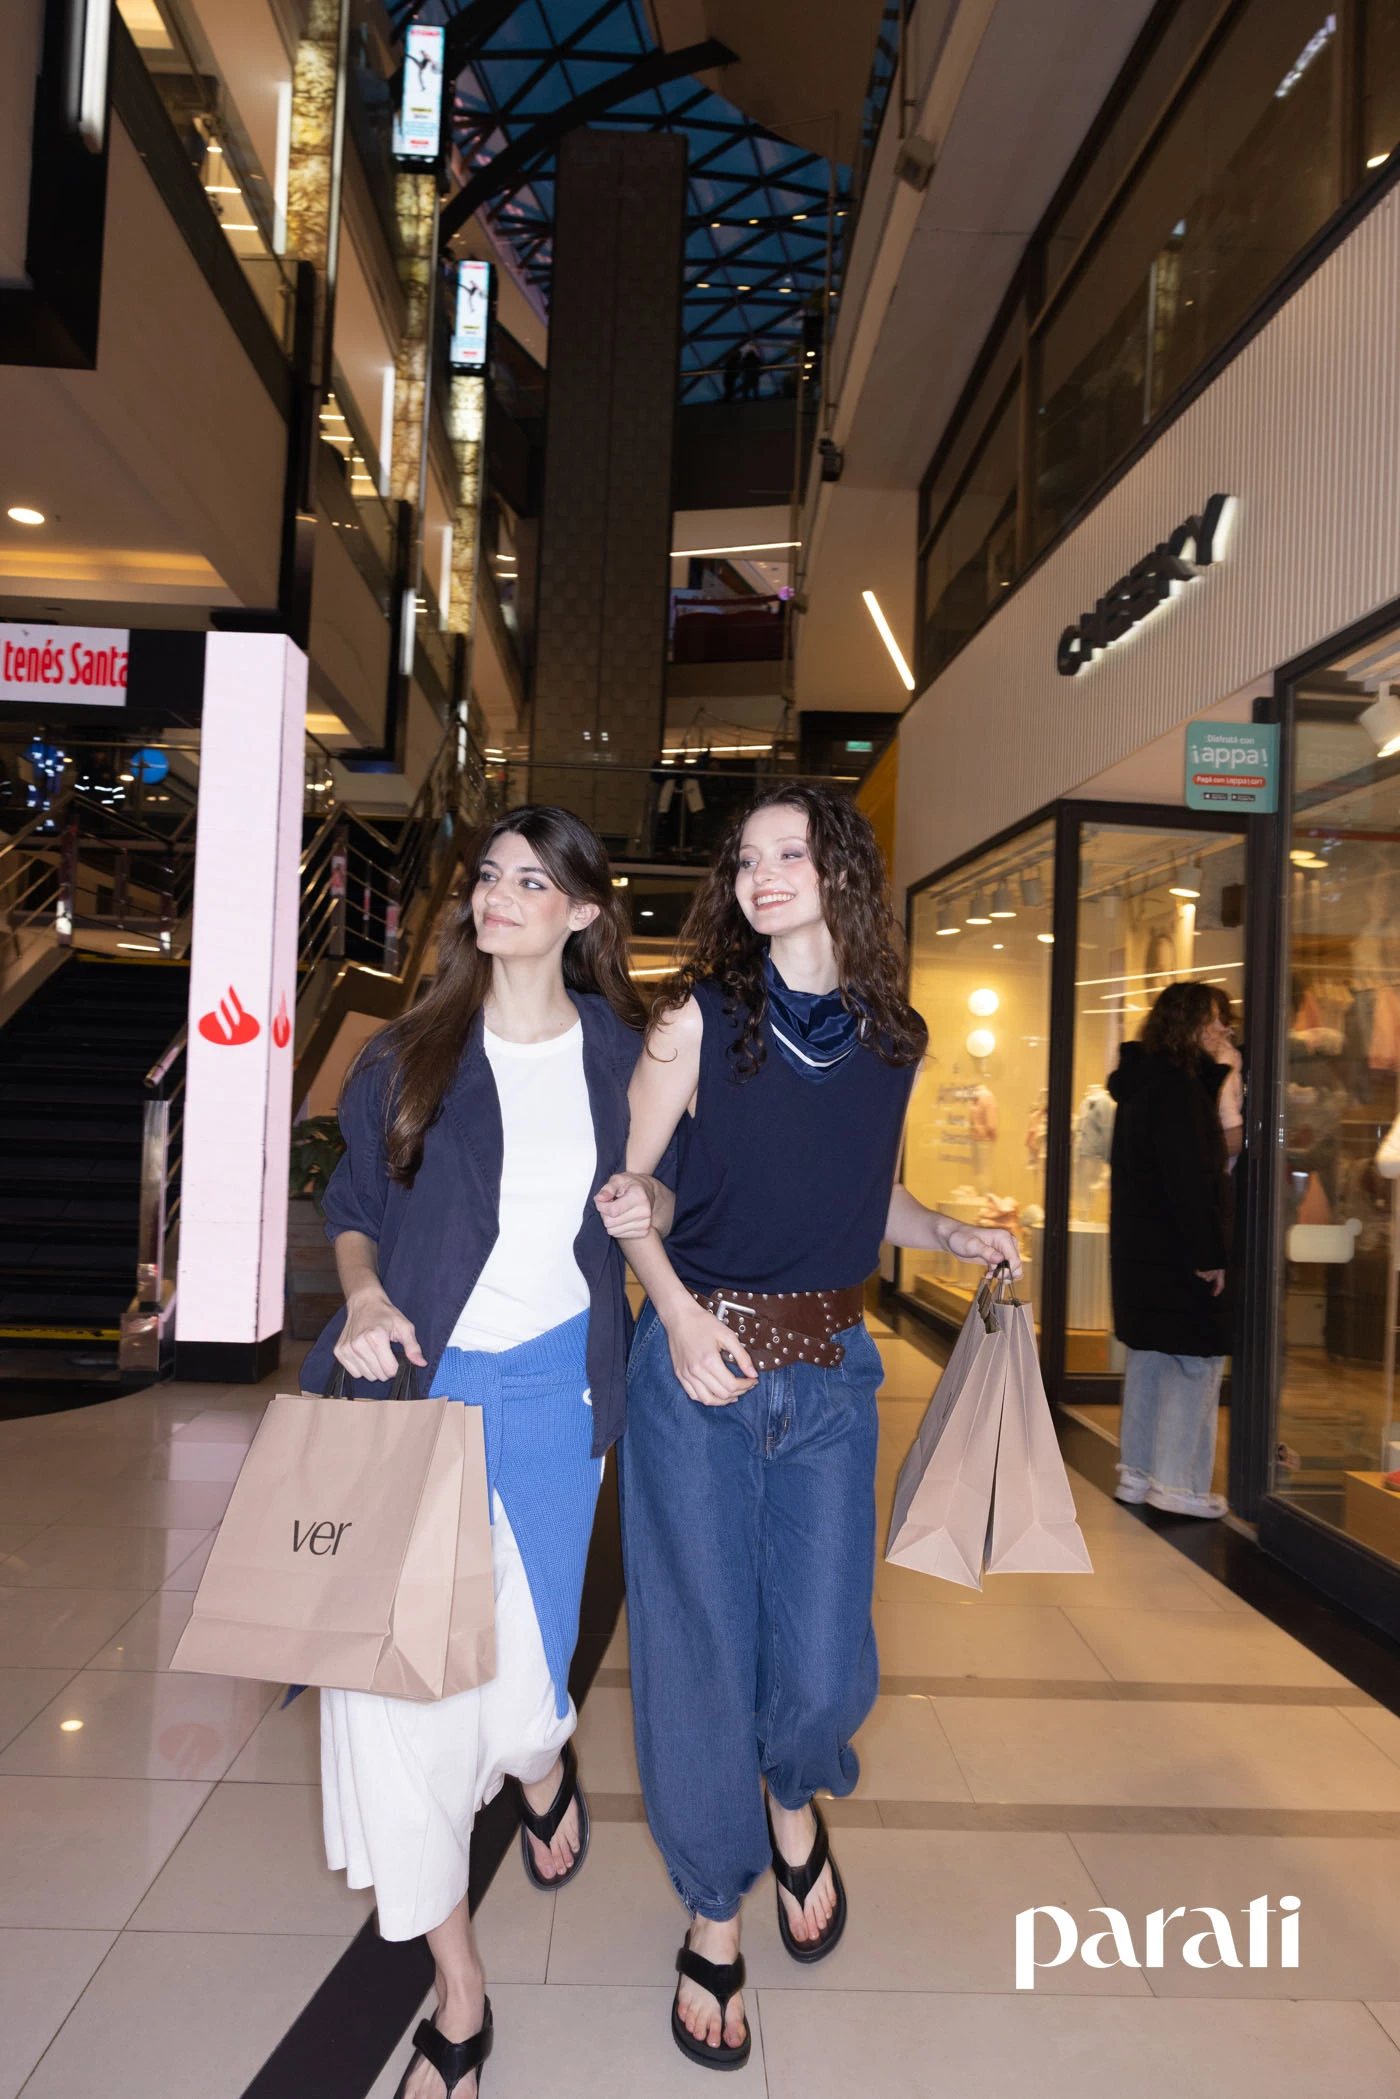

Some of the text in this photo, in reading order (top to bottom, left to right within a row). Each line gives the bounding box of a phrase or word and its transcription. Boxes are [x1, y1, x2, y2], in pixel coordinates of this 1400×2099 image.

[3, 639, 129, 688] tenés Santa
[1191, 744, 1269, 769] ¡appa!
[1240, 737, 1255, 745] con
[293, 1519, 353, 1556] ver
